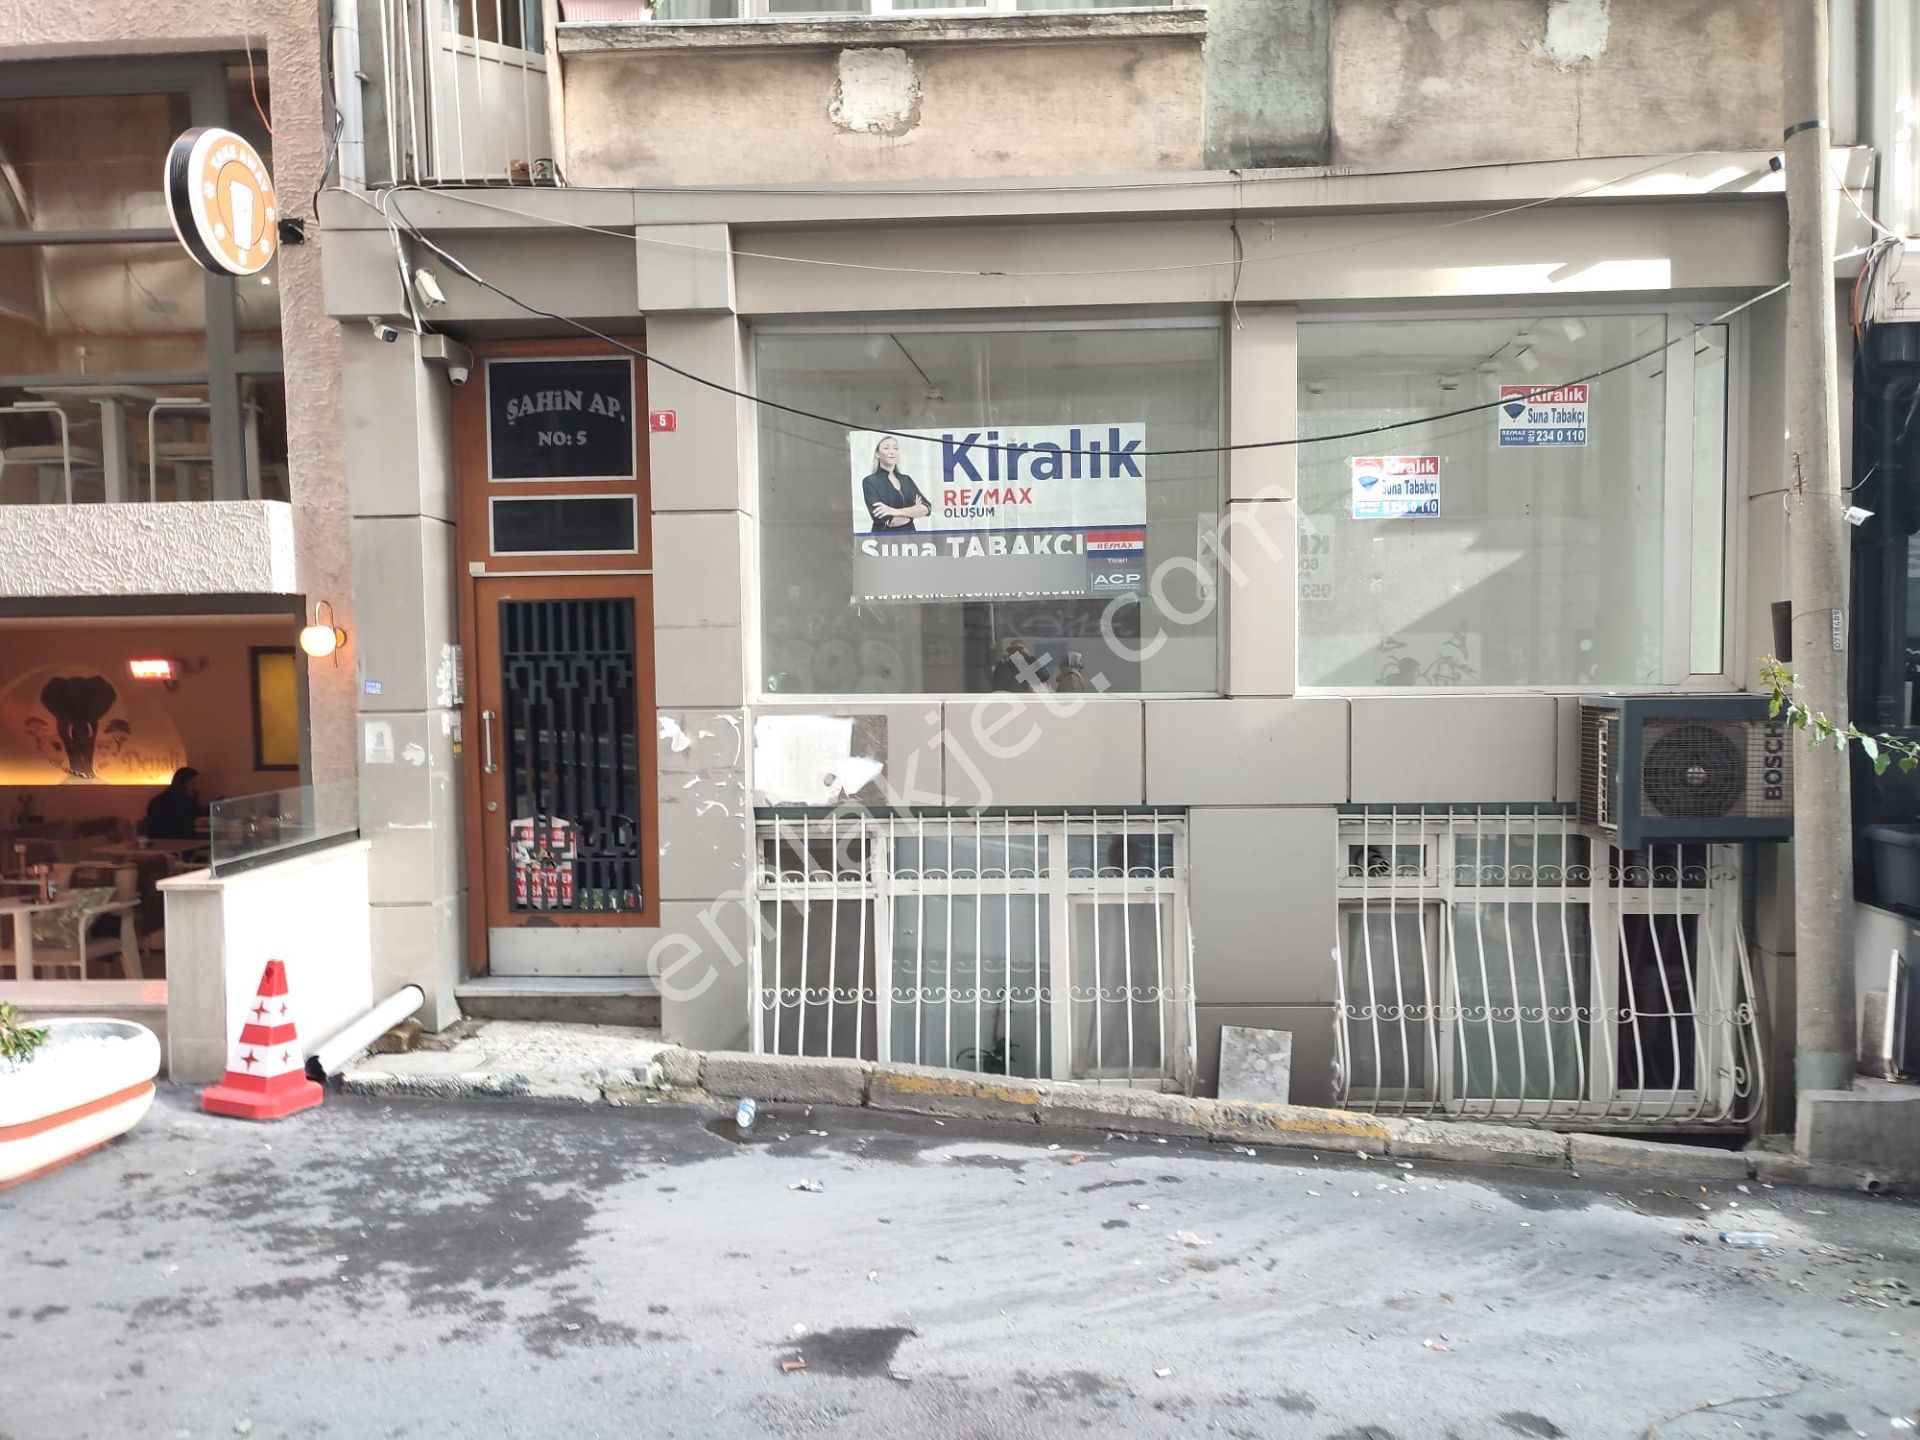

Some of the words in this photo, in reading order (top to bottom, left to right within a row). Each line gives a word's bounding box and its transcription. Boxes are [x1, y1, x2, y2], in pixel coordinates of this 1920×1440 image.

[1530, 387, 1584, 402] Kiralık
[659, 415, 667, 427] 5
[1528, 407, 1549, 424] Suna
[1551, 407, 1585, 428] Tabakçı
[538, 431, 572, 447] NO:
[576, 431, 588, 445] 5
[1536, 430, 1554, 442] 234
[1557, 430, 1564, 442] 0
[1566, 430, 1584, 442] 110
[942, 427, 1143, 482] Kiralık
[1404, 479, 1437, 497] Tabakçı
[943, 487, 1033, 507] RE/MAX
[943, 506, 995, 519] OLUŞUM
[1097, 542, 1134, 550] RE/MAX
[1093, 573, 1141, 585] ACP
[1764, 725, 1783, 800] BOSCH
